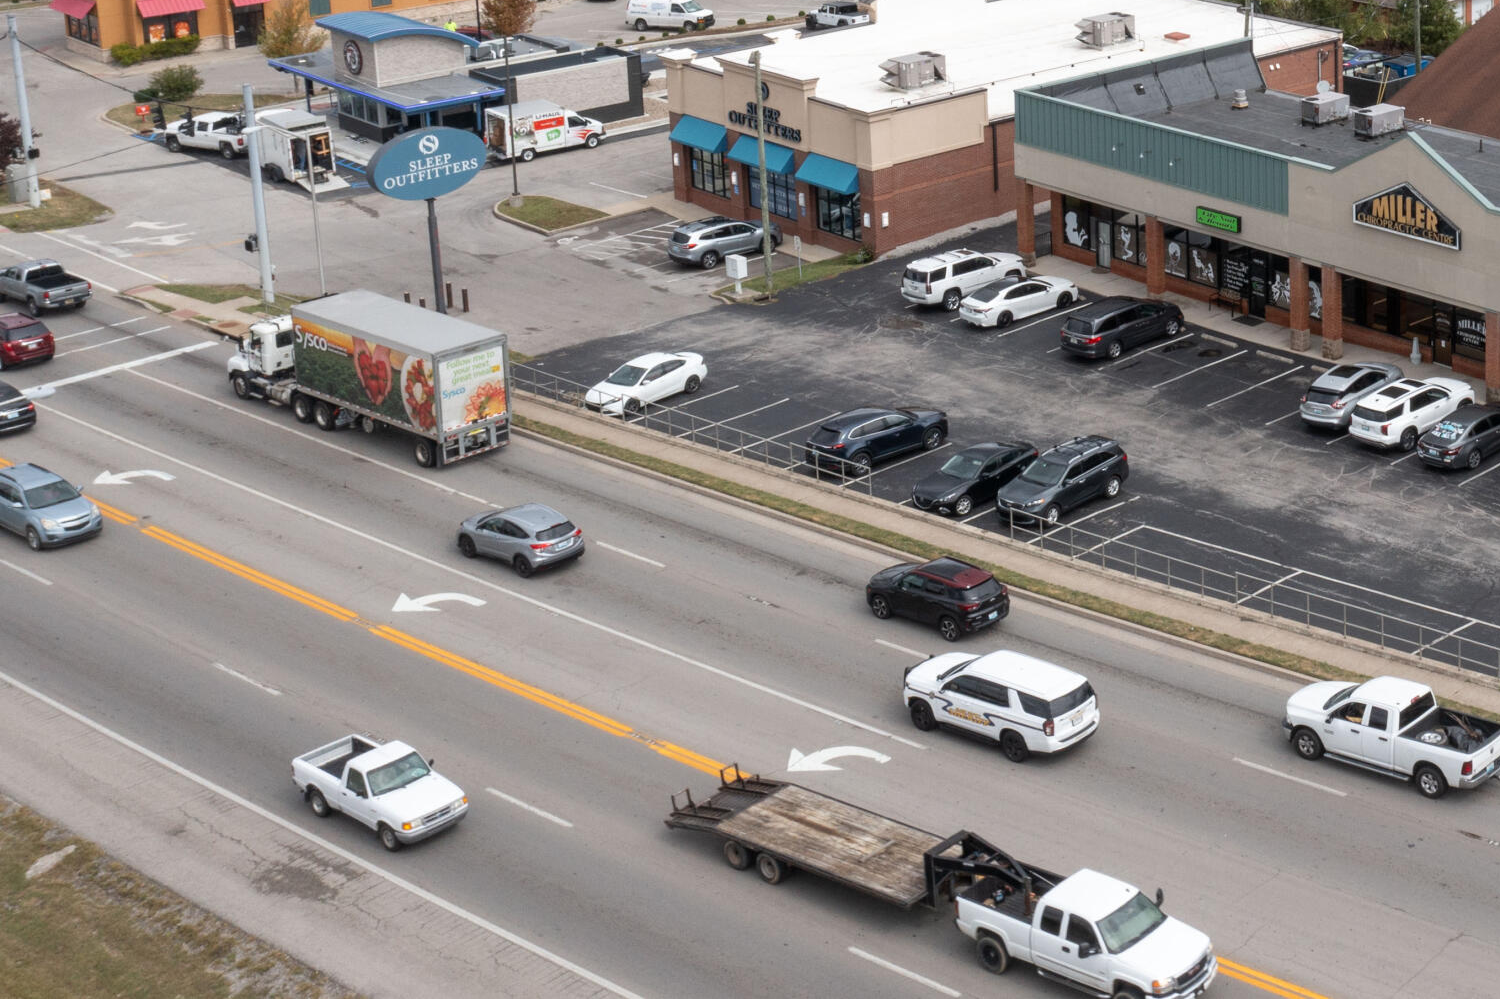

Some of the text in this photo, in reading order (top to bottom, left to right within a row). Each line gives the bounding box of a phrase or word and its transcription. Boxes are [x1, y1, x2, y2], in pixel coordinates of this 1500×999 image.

[728, 110, 802, 143] OUTFTTERS
[383, 157, 479, 190] OUTFITTERS
[409, 153, 452, 173] SLEEP
[1357, 212, 1454, 244] CHIROPRACTIC CENTRE
[1371, 194, 1438, 232] MILLER
[442, 387, 466, 399] Sysco
